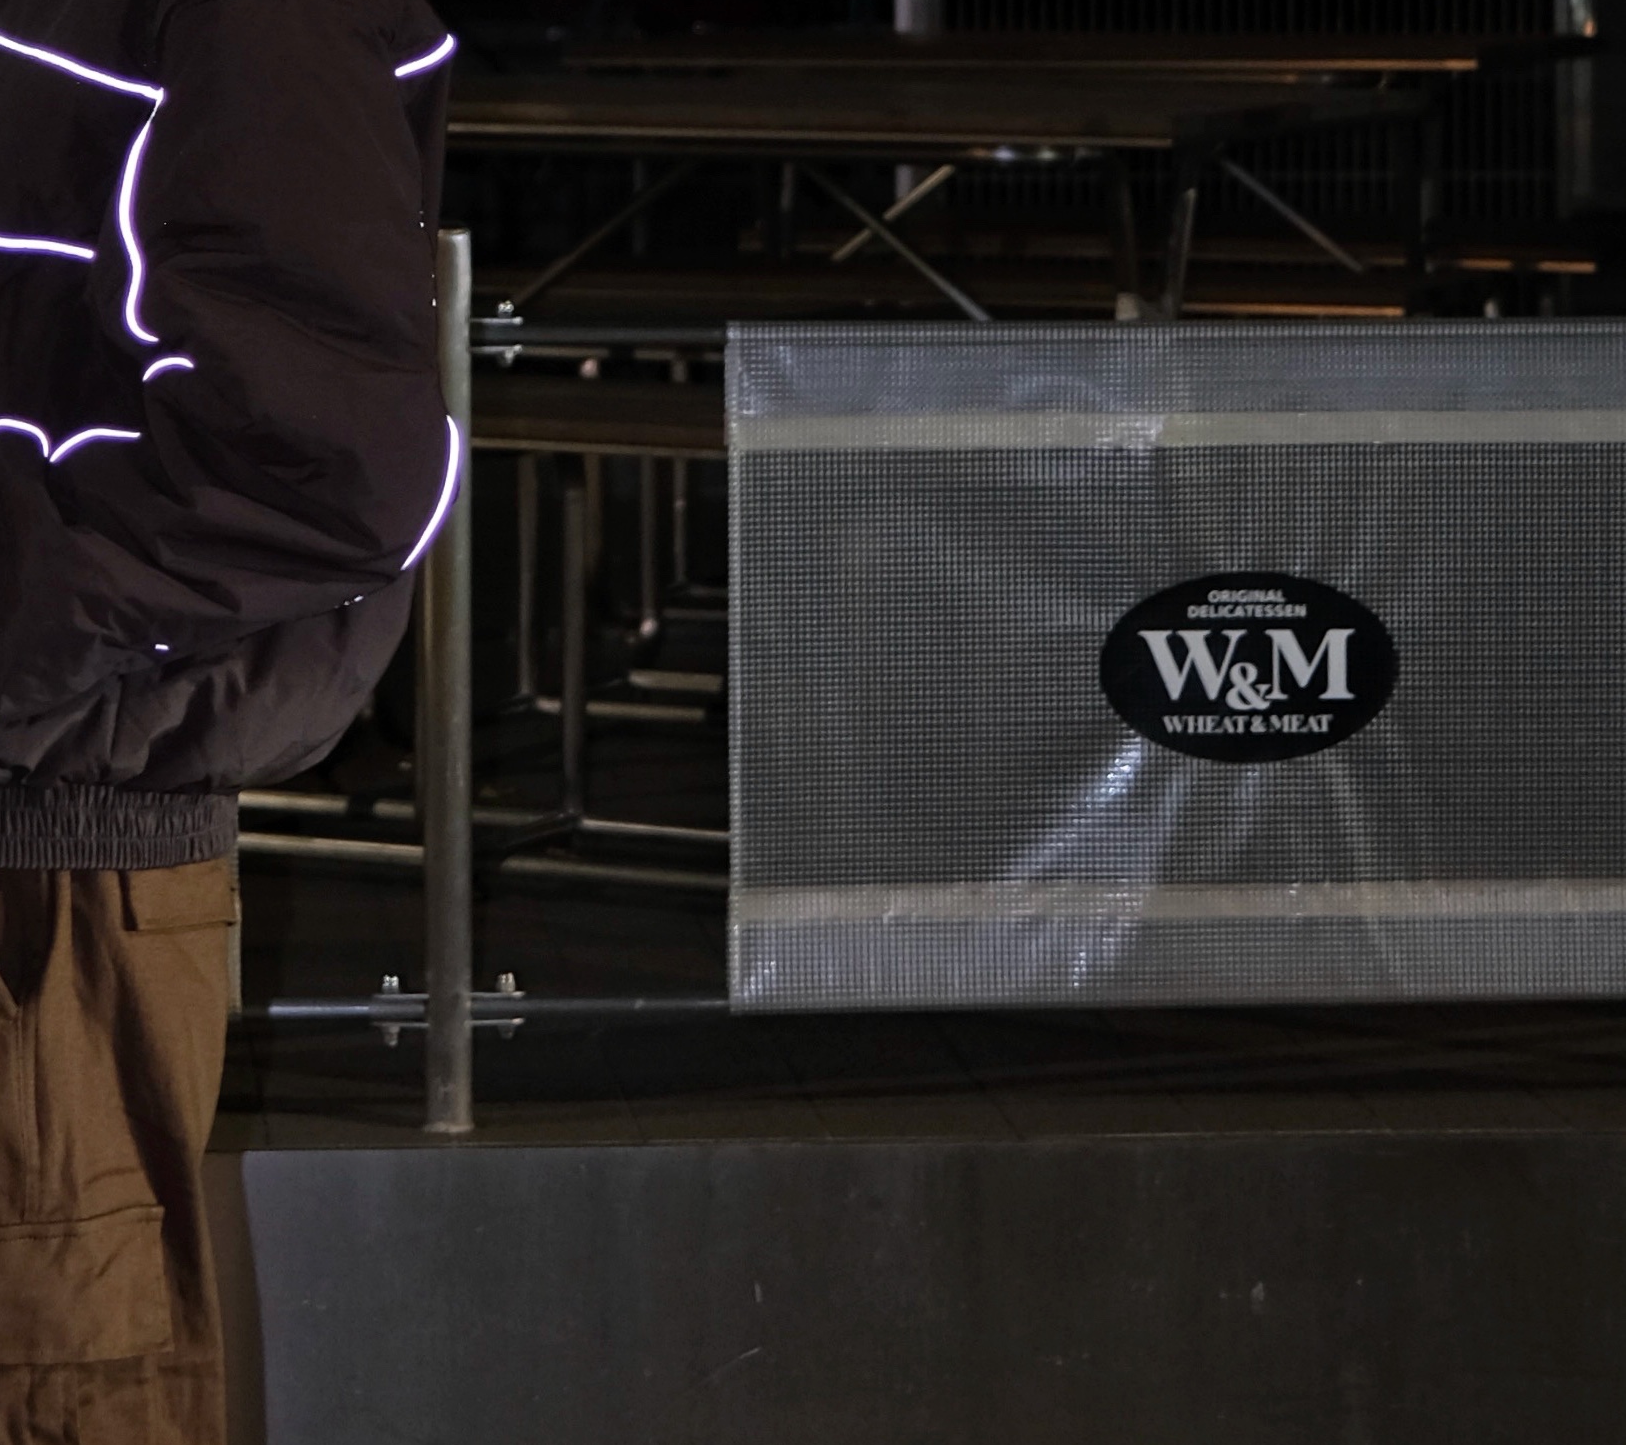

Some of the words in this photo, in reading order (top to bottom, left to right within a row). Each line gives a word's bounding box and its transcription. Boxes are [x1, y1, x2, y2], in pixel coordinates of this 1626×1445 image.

[1207, 589, 1286, 604] ORIGINAL
[1187, 604, 1307, 619] DELICATESSEN
[1137, 628, 1356, 710] W&M
